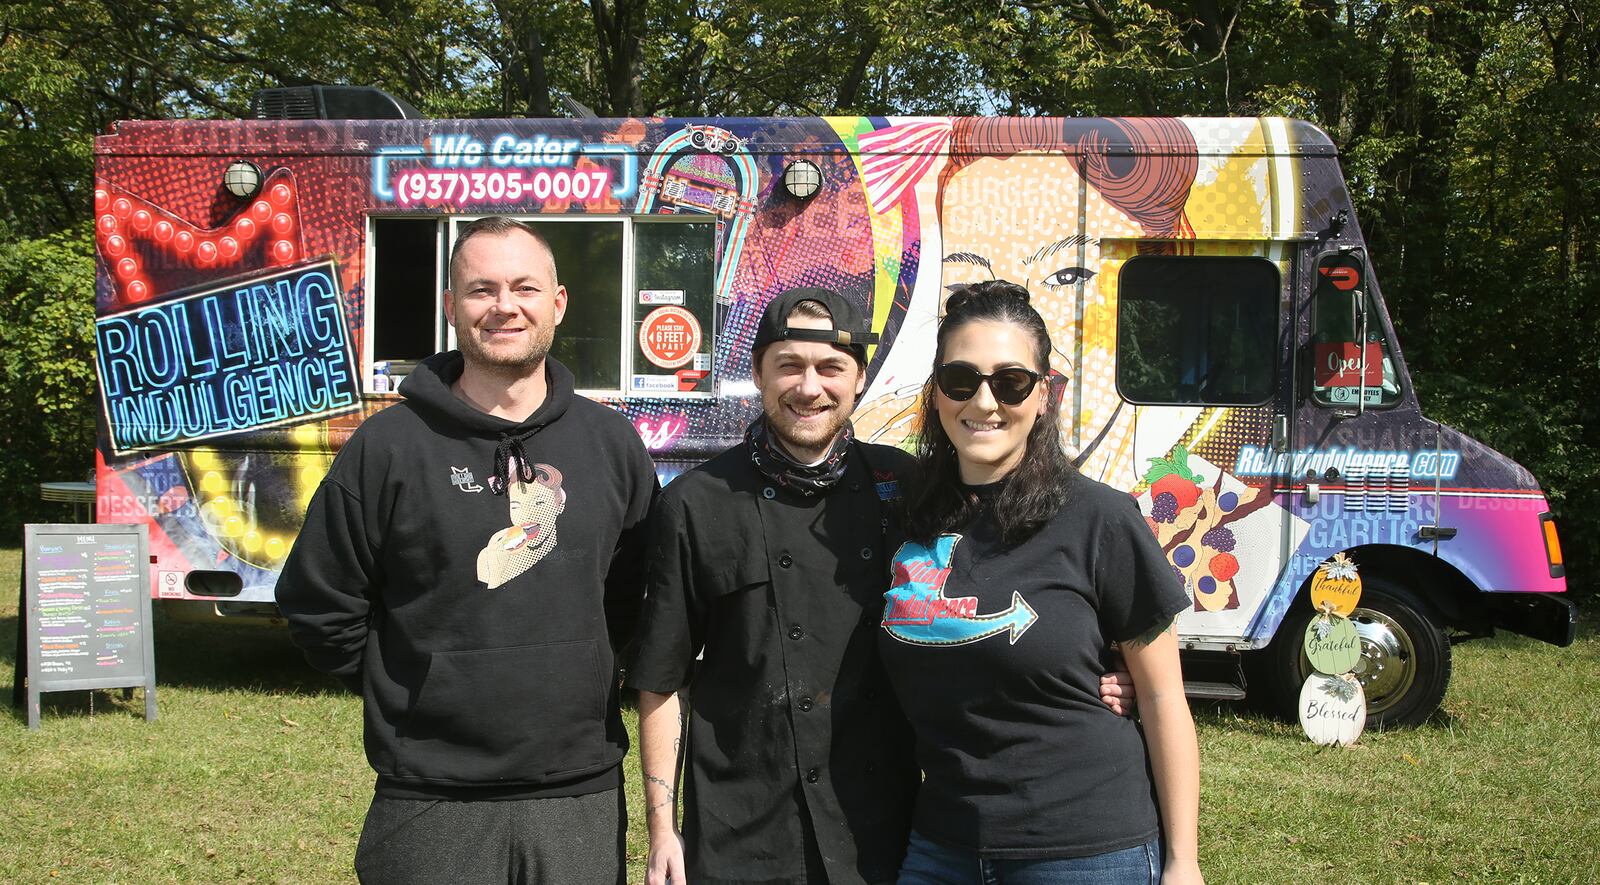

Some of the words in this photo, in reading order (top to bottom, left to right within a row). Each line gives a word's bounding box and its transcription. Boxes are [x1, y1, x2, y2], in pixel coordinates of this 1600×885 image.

[432, 134, 484, 165] We
[491, 134, 579, 165] Cater
[398, 172, 609, 204] (937)305-0007
[96, 271, 345, 397] ROLLING
[656, 331, 663, 342] 6
[663, 331, 685, 342] FEET
[1328, 351, 1370, 378] Open
[111, 350, 353, 449] INDULGENCE
[143, 473, 181, 494] TOP
[98, 495, 198, 518] DESSERTS
[1314, 576, 1359, 596] Thankful
[1308, 635, 1356, 656] Grateful
[1306, 699, 1362, 722] Blessed
